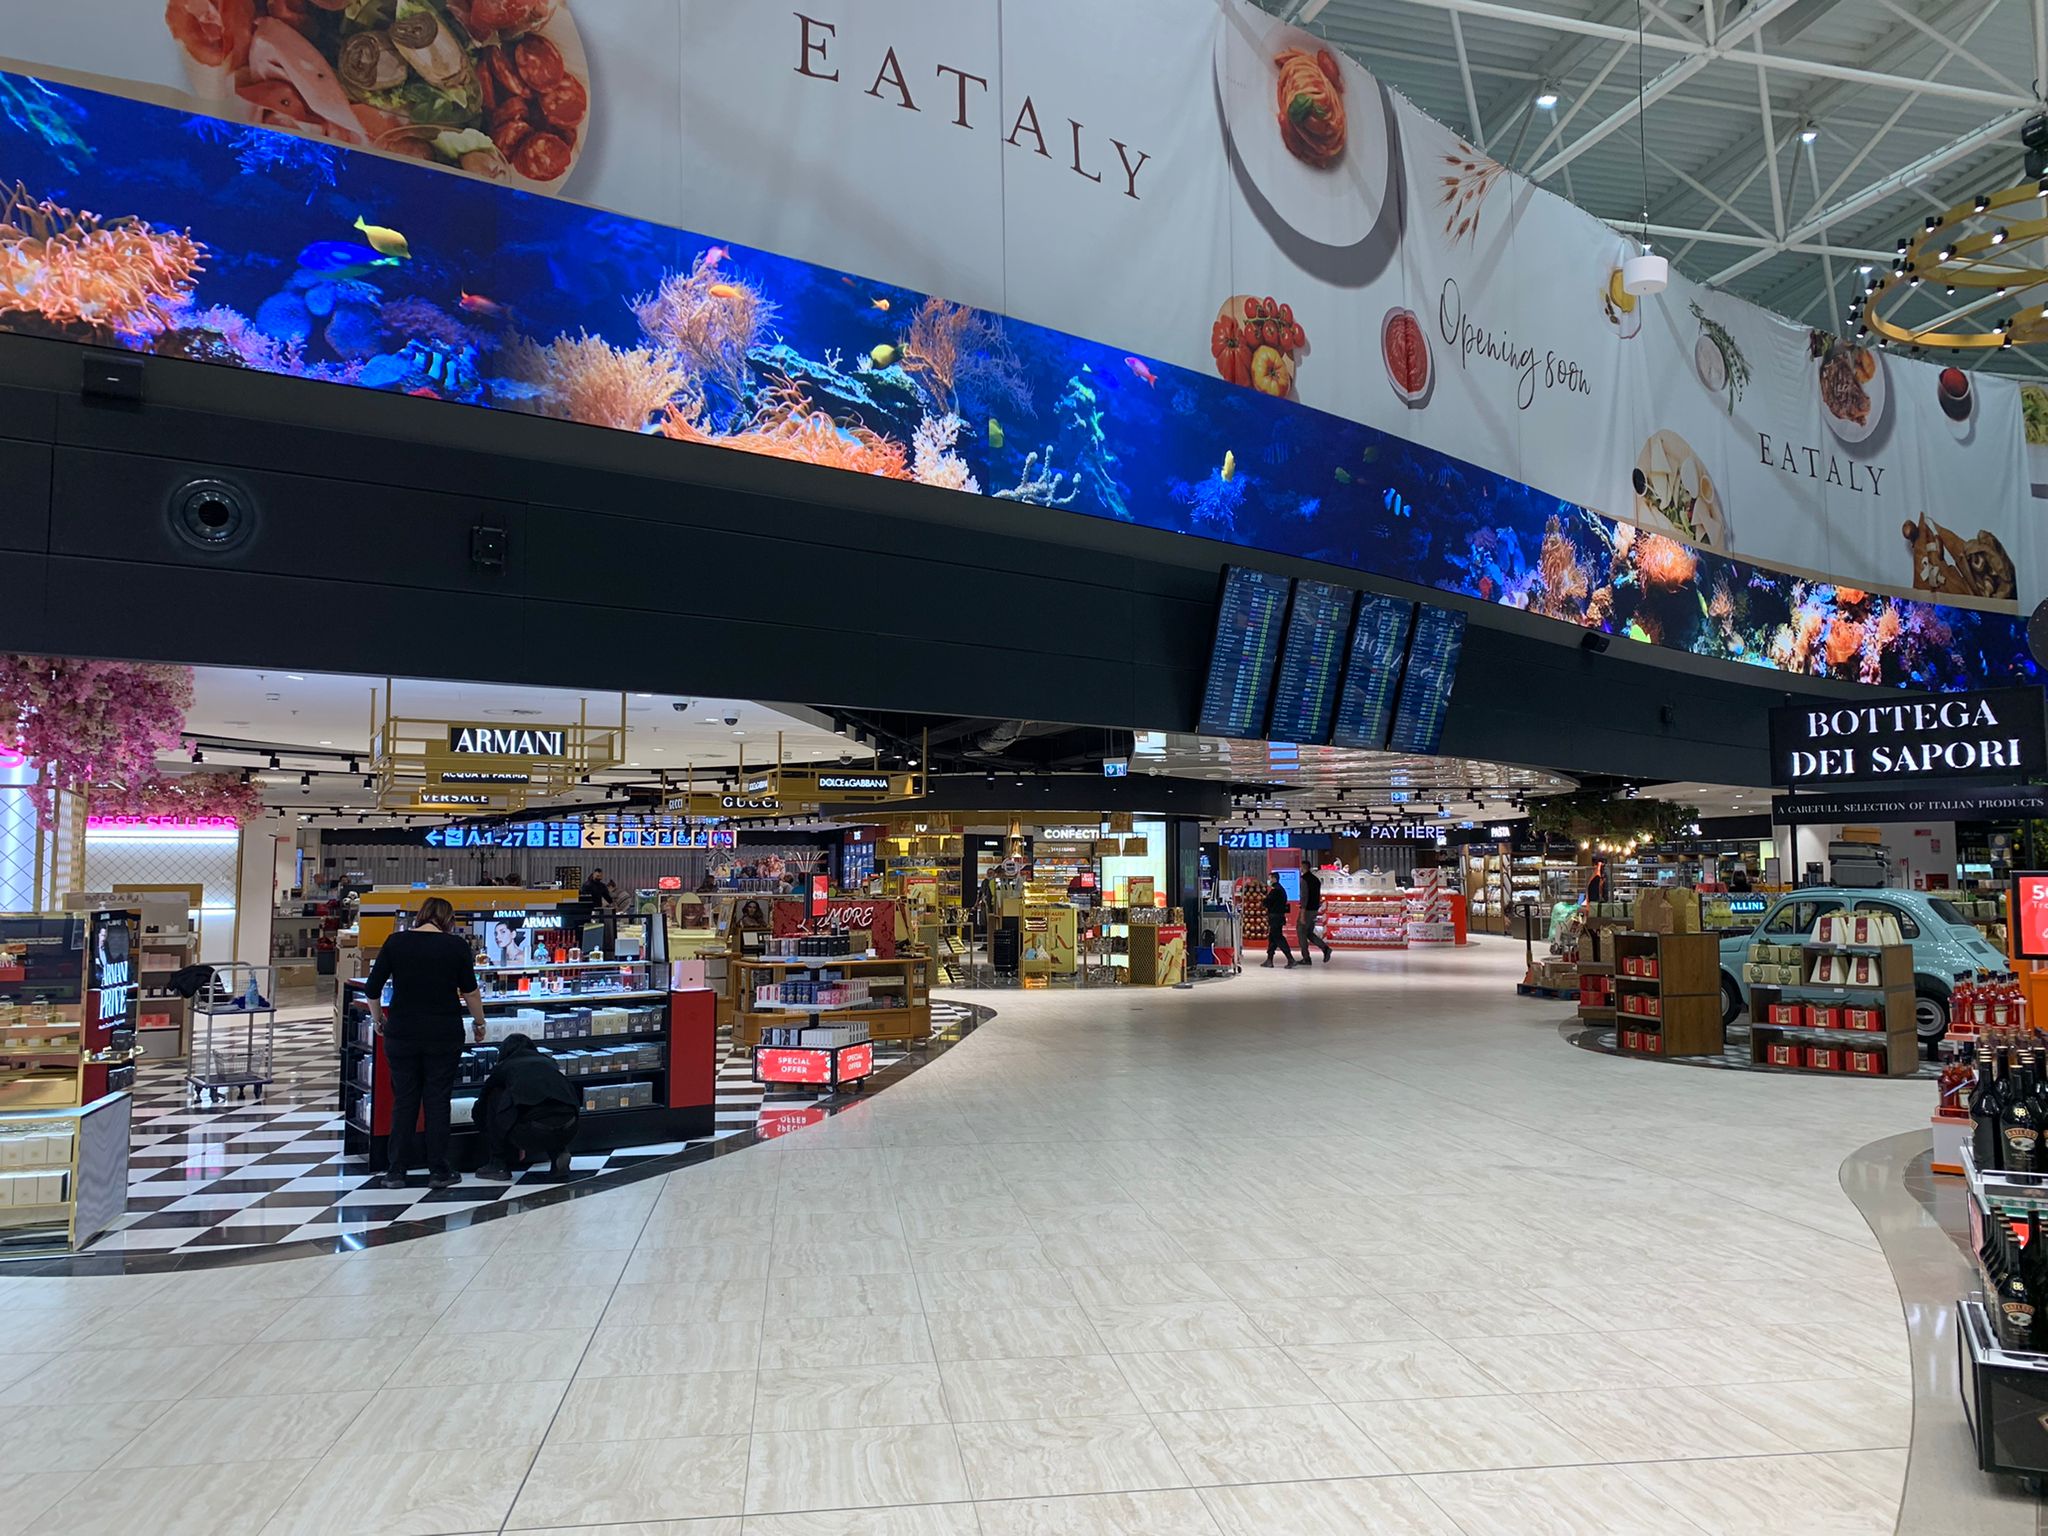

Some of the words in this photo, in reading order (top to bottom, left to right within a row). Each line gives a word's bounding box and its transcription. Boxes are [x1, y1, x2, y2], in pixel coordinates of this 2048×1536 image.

[793, 12, 1151, 200] EATALY
[1440, 278, 1542, 410] Opening
[1545, 350, 1591, 395] soon
[1757, 432, 1885, 496] EATALY
[1807, 699, 1999, 738] BOTTEGA
[454, 727, 562, 756] ARMANI
[1791, 748, 1855, 777] DEI
[1871, 738, 2022, 773] SAPORI
[819, 777, 888, 788] DOLCE&GABBANA
[422, 795, 489, 803] VERSACE
[722, 796, 780, 808] GUCCI
[1777, 805, 1785, 814] A
[1787, 804, 1840, 814] CAREFULL
[1843, 802, 1906, 813] SELECTION
[1909, 800, 1926, 810] OF
[1928, 799, 1975, 810] ITALIAN
[1978, 797, 2045, 809] PRODUCTS
[548, 830, 560, 847] E
[1043, 828, 1101, 840] CONFECTI
[1370, 826, 1400, 839] PAY
[1404, 825, 1446, 839] HERE
[1491, 826, 1511, 838] PASTA
[1219, 834, 1247, 848] 1-27
[1265, 834, 1274, 848] E
[522, 916, 562, 928] ARMANI
[777, 1057, 811, 1066] SPECIAL
[780, 1066, 808, 1074] OFFER
